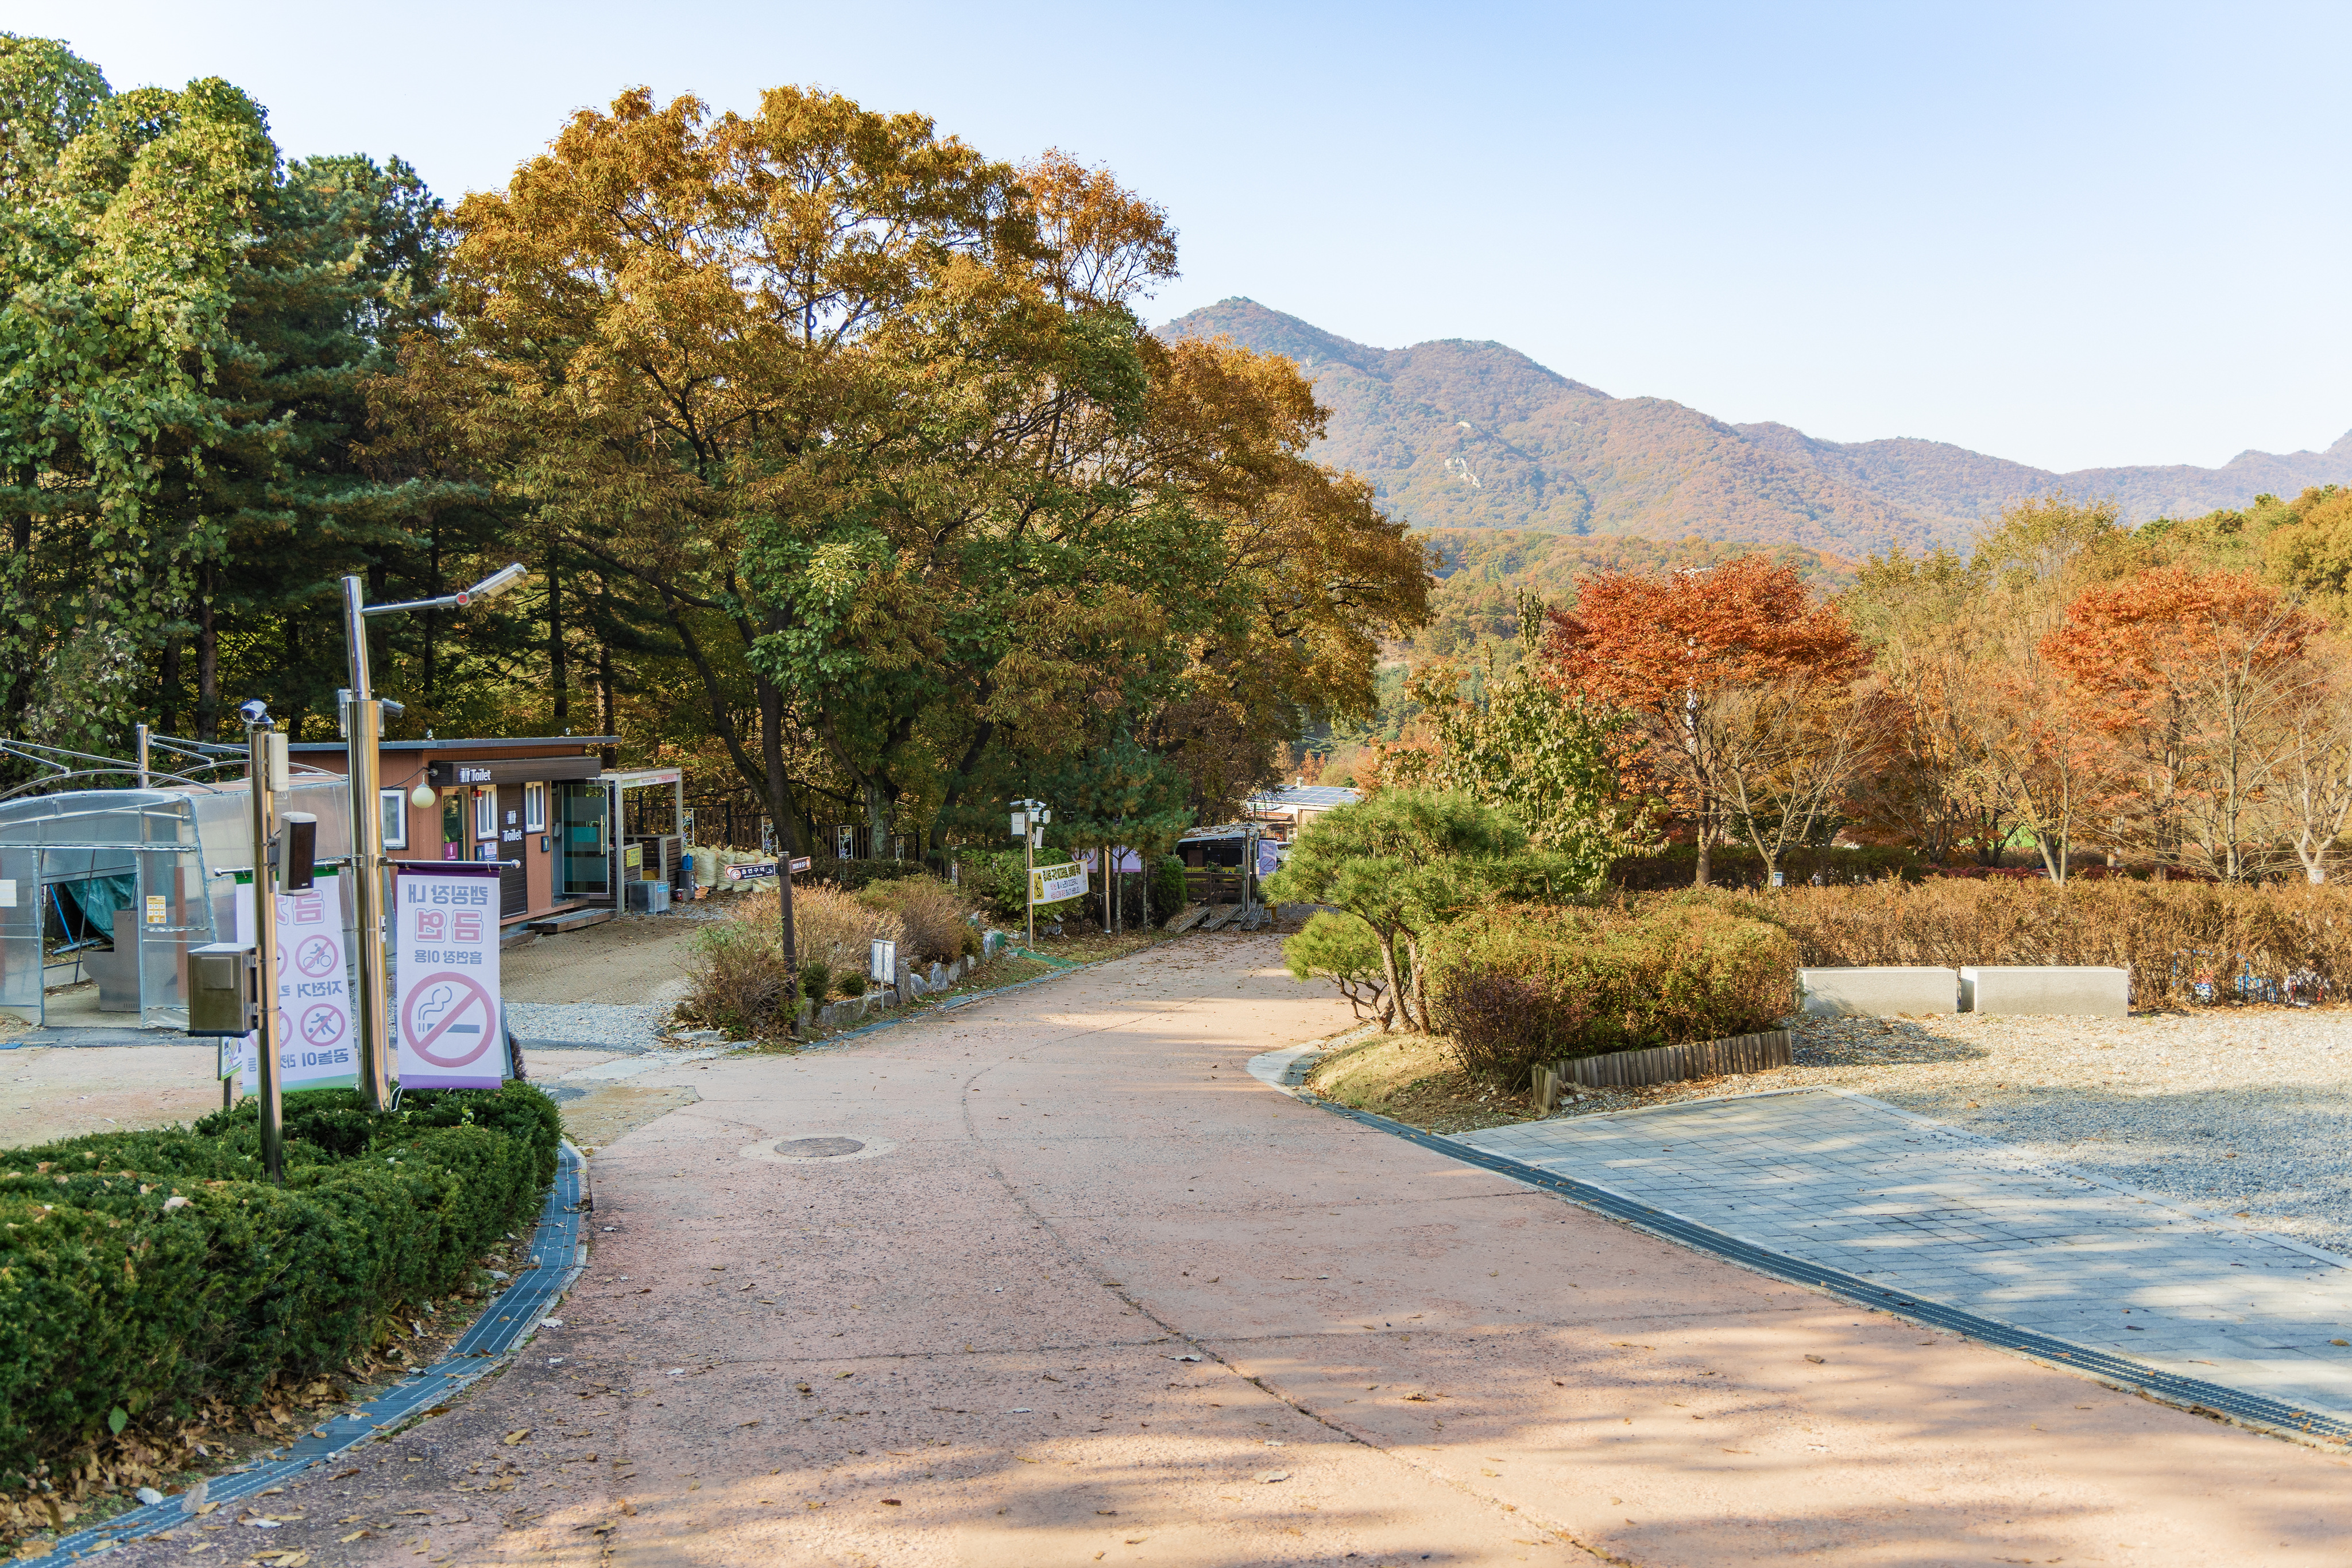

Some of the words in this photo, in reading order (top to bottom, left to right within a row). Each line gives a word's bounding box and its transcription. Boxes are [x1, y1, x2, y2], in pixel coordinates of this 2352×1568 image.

[470, 768, 491, 781] Toilet
[502, 828, 522, 842] Toilet
[1042, 869, 1052, 882] 경사로
